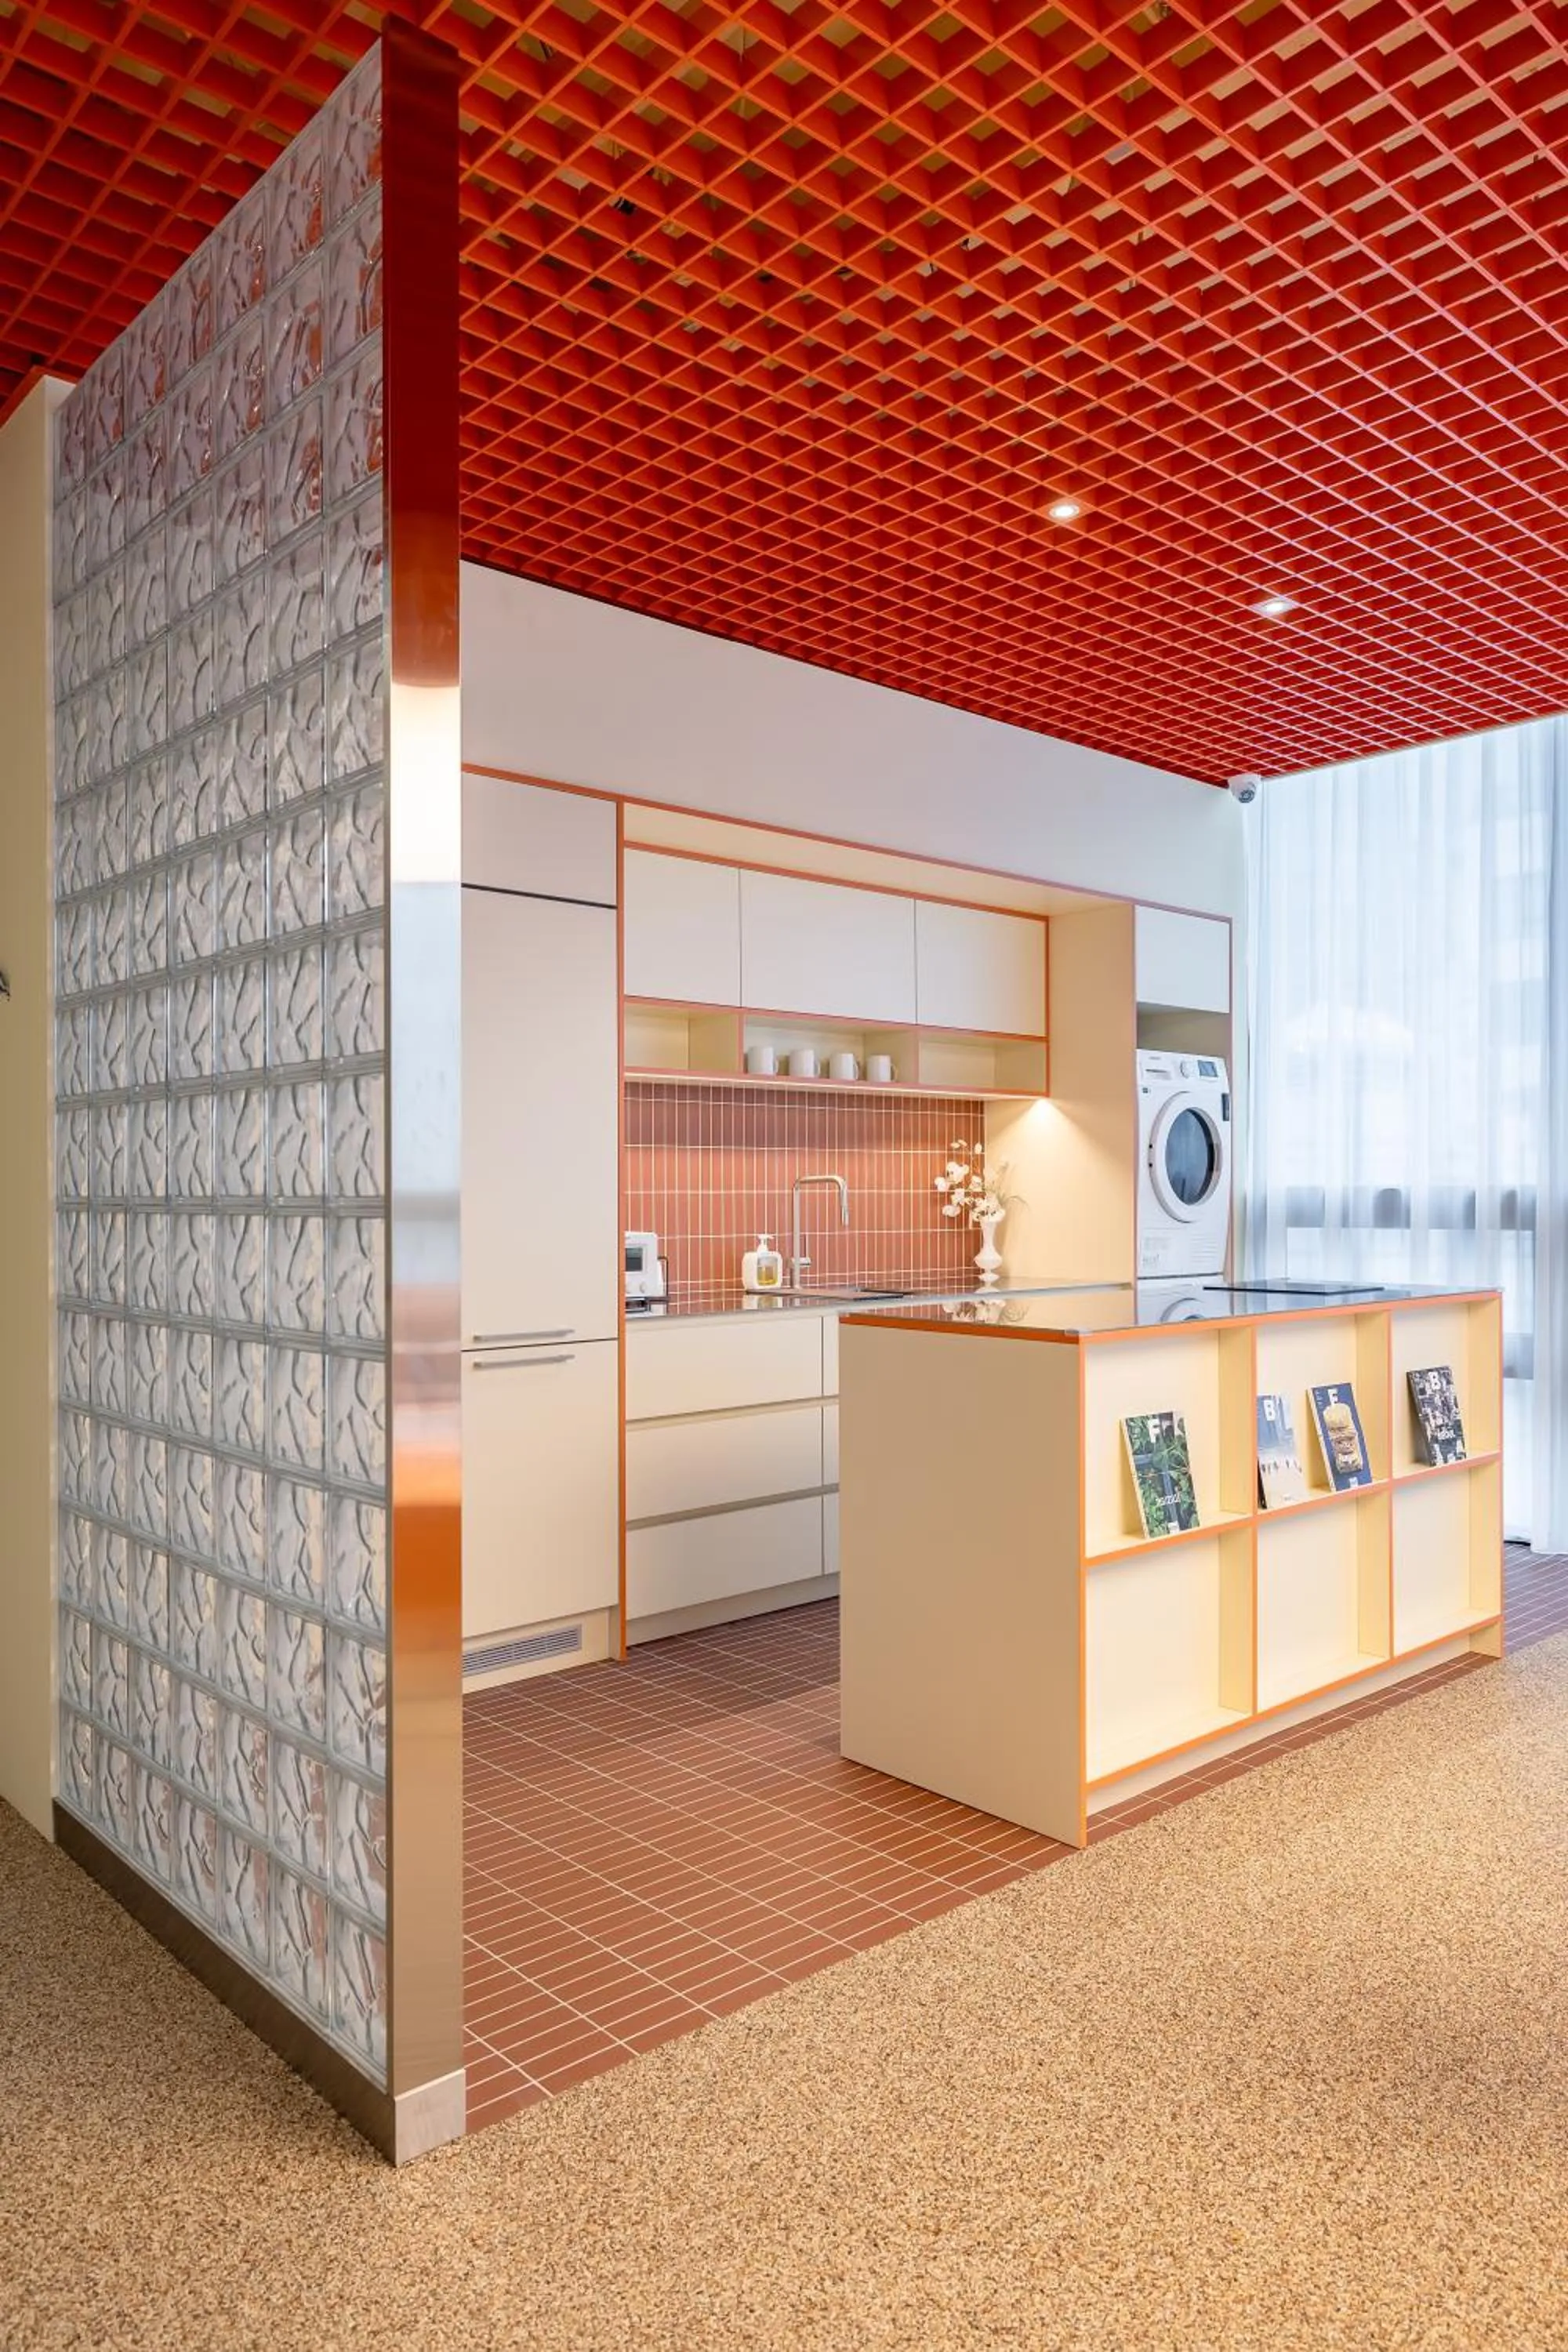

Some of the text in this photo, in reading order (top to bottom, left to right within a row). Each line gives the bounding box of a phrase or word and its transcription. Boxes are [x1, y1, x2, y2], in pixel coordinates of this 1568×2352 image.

[1428, 1371, 1441, 1390] B
[1264, 1400, 1276, 1421] B
[1147, 1418, 1160, 1443] F
